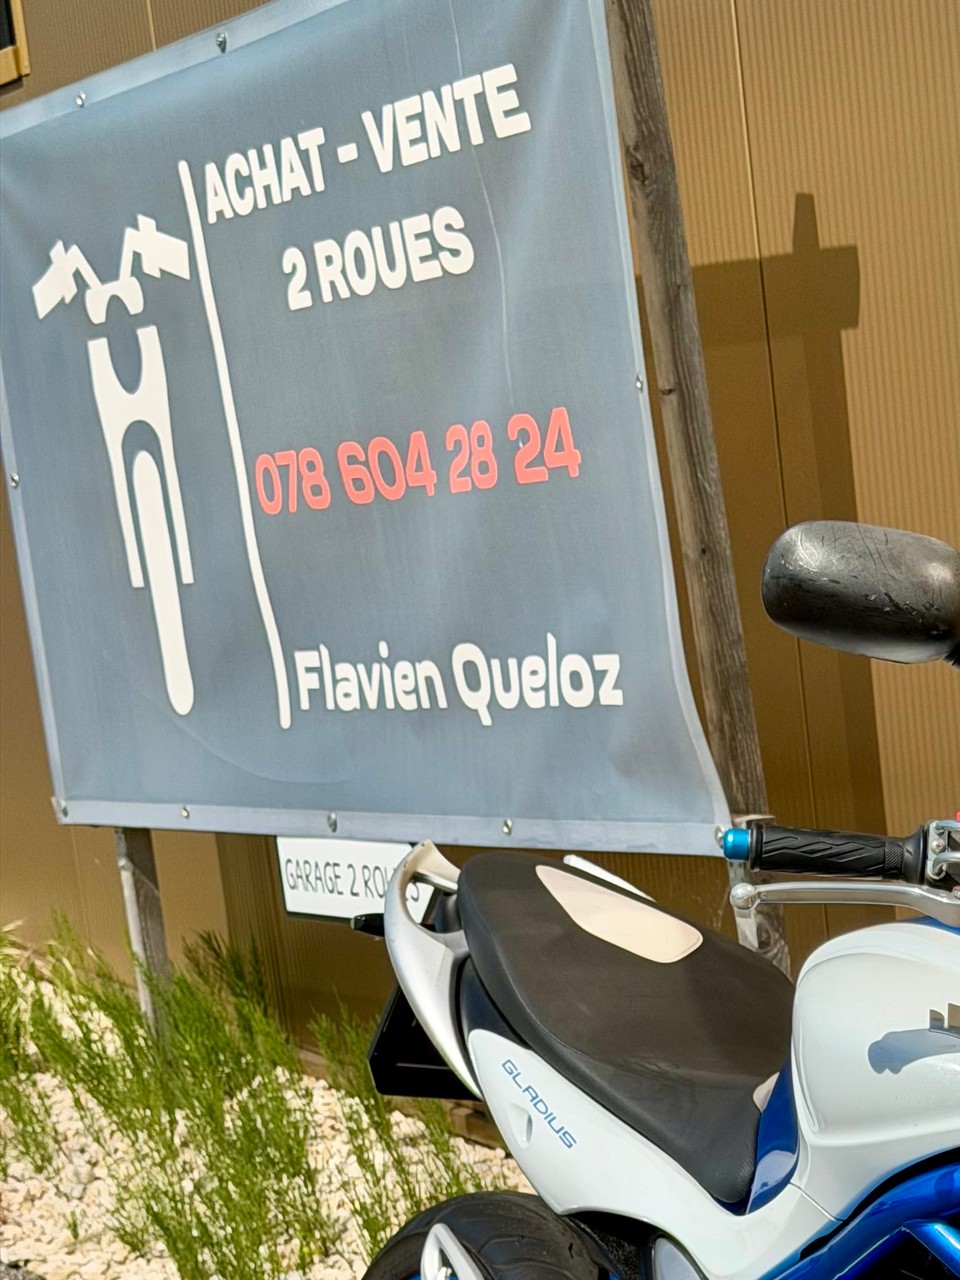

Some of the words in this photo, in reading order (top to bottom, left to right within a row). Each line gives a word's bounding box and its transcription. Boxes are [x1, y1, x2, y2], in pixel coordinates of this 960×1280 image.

[205, 127, 325, 224] ACHAT
[361, 63, 532, 173] VENTE
[282, 246, 313, 311] 2
[313, 206, 475, 303] ROUES
[255, 447, 331, 515] 078
[337, 431, 437, 505] 604
[445, 420, 498, 493] 28
[507, 406, 582, 484] 24
[294, 641, 448, 711] Flavien
[452, 632, 623, 726] Queloz
[285, 858, 344, 895] GARAGE
[347, 864, 360, 896] 2
[501, 1058, 577, 1149] GLADIUS
